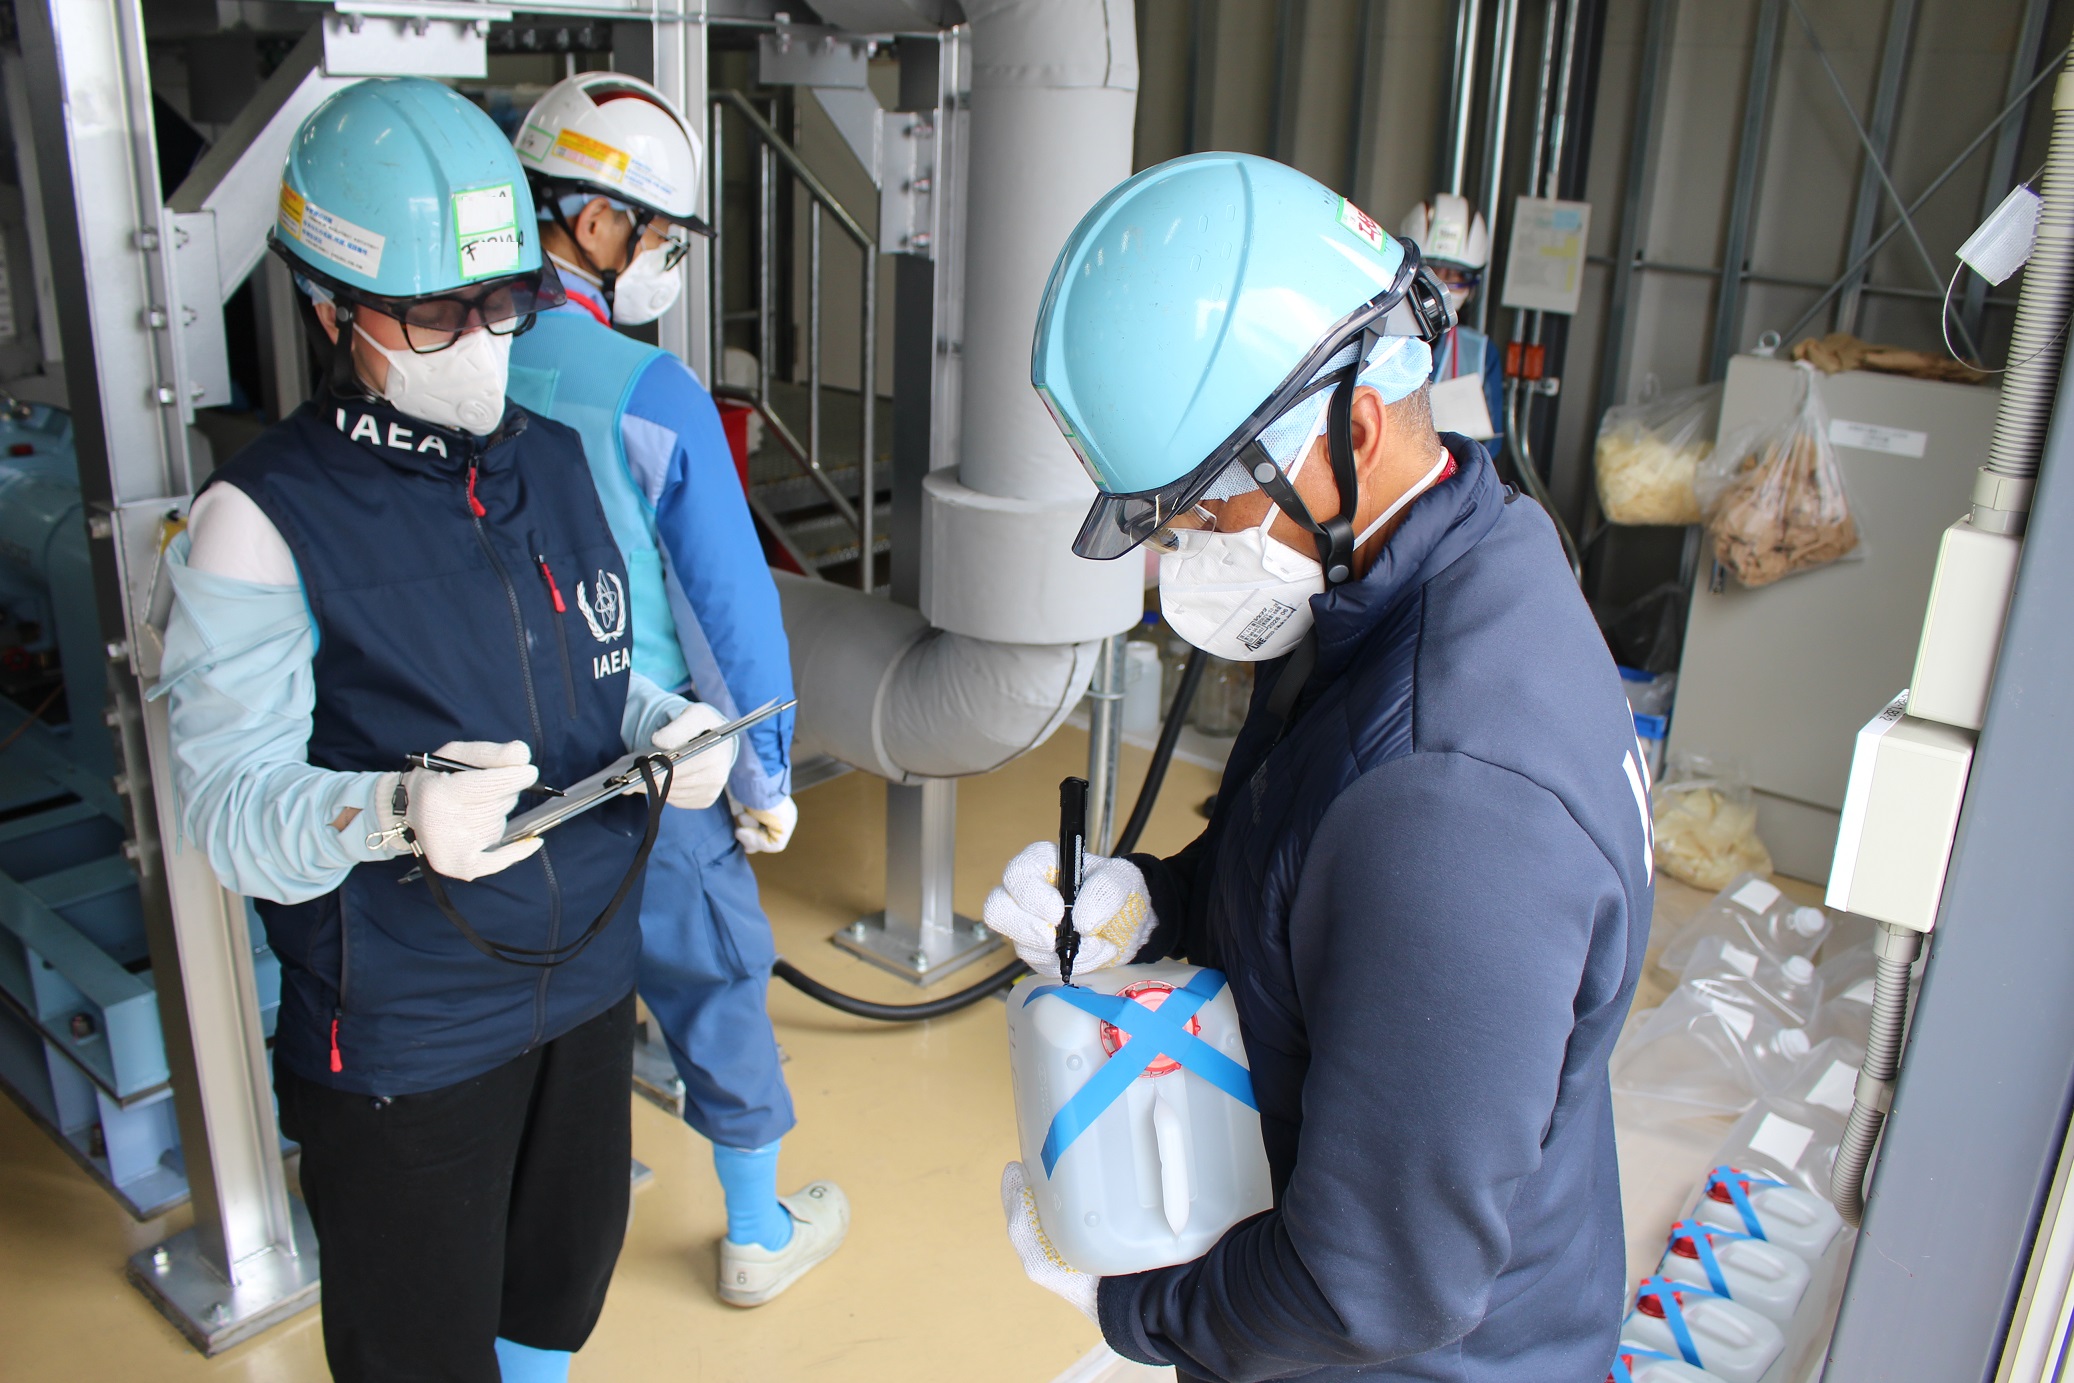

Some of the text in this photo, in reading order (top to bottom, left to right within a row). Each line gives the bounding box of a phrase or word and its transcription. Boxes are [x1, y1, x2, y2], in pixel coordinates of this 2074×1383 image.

[336, 407, 448, 459] IAEA
[593, 647, 631, 680] IAEA
[808, 1185, 828, 1199] 6
[736, 1271, 747, 1285] 6
